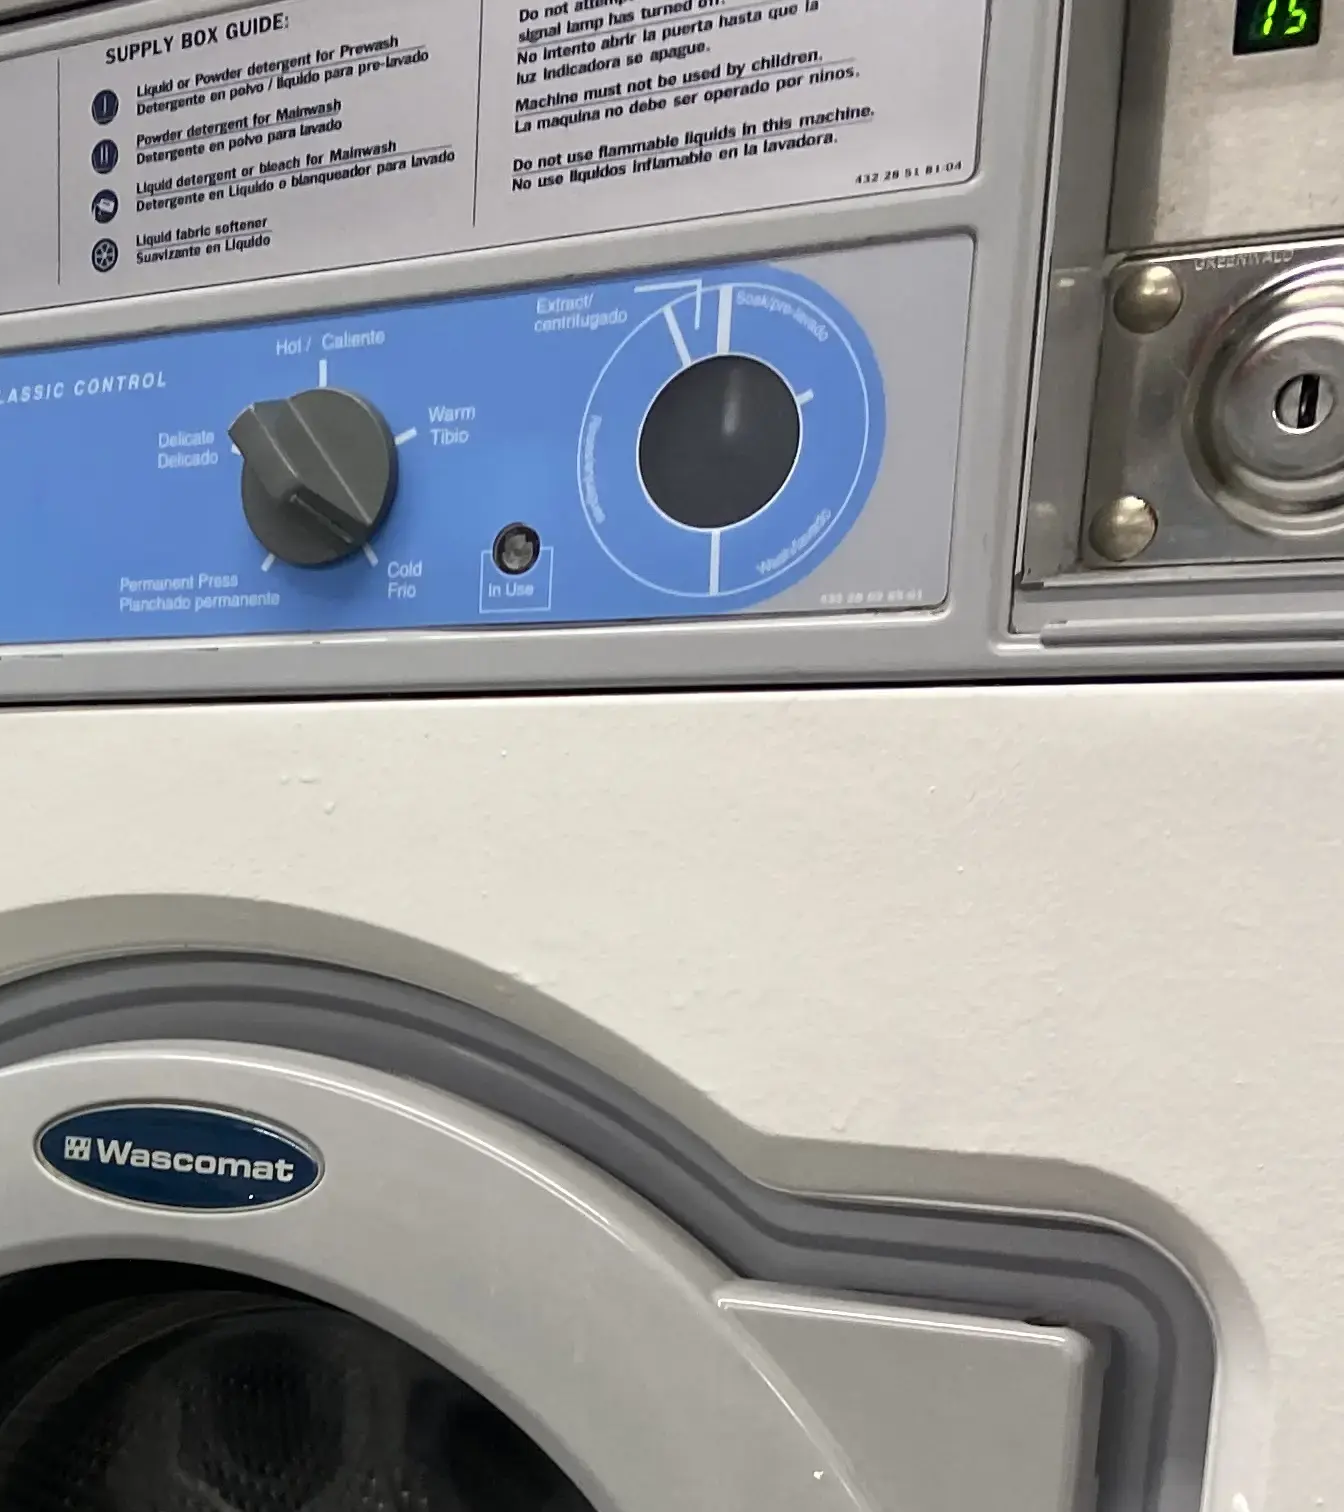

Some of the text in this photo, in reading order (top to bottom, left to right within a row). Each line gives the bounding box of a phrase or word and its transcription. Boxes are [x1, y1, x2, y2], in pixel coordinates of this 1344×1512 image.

[517, 51, 538, 65] No
[601, 32, 637, 50] abrir
[643, 28, 656, 42] la
[662, 19, 713, 41] puerta
[718, 9, 762, 28] hasta
[768, 4, 798, 20] que
[806, 0, 819, 13] la
[518, 22, 561, 43] signal
[567, 16, 604, 33] lamp
[608, 11, 634, 26] has
[641, 0, 692, 19] turned
[519, 9, 539, 23] Do
[544, 3, 568, 17] not
[105, 12, 289, 64] SUPPLY BOX GUIDE:
[136, 34, 399, 99] Liquid or Powder detergent for Prewash
[136, 93, 206, 116] Detergente
[210, 89, 226, 102] en
[229, 83, 264, 101] polvo
[324, 65, 354, 83] para
[358, 49, 430, 77] pre-lavado
[515, 50, 823, 113] Machine must not be used by children.
[516, 41, 710, 85] luz indicadora se apague.
[514, 65, 860, 134] La maquina no debe ser operado por ninos.
[136, 98, 342, 148] Powder detergent for Mainwash
[136, 118, 343, 165] Detergente en polvo para lavado
[513, 105, 876, 172] Do not use flammable liquids in this machine.
[136, 139, 397, 196] Liquid detergent or bleach for Mainwash
[136, 192, 205, 213] Detergente
[209, 189, 224, 201] en
[279, 179, 287, 190] o
[291, 164, 372, 187] blanqueador
[376, 159, 407, 176] para
[411, 149, 456, 169] lavado
[512, 177, 532, 191] No
[538, 174, 564, 188] use
[632, 148, 713, 173] inflamable
[719, 146, 739, 160] en
[744, 142, 758, 157] la
[763, 132, 838, 154] lavadora.
[136, 217, 268, 248] Liquid fabric softener
[136, 246, 201, 264] Suavizante
[205, 243, 221, 255] en
[275, 336, 302, 356] Hot
[322, 329, 386, 351] Caliente
[74, 371, 167, 397] CONTROL
[428, 404, 476, 424] Warm
[158, 430, 215, 450] Delicate
[431, 427, 470, 446] Tibio
[157, 450, 219, 469] Delicado
[120, 572, 239, 593] Permanent Press
[387, 559, 423, 579] Cold
[387, 581, 417, 600] Frio
[488, 582, 535, 598] In Use
[120, 591, 281, 613] Planchado permanente
[96, 1137, 294, 1183] Wascomat
